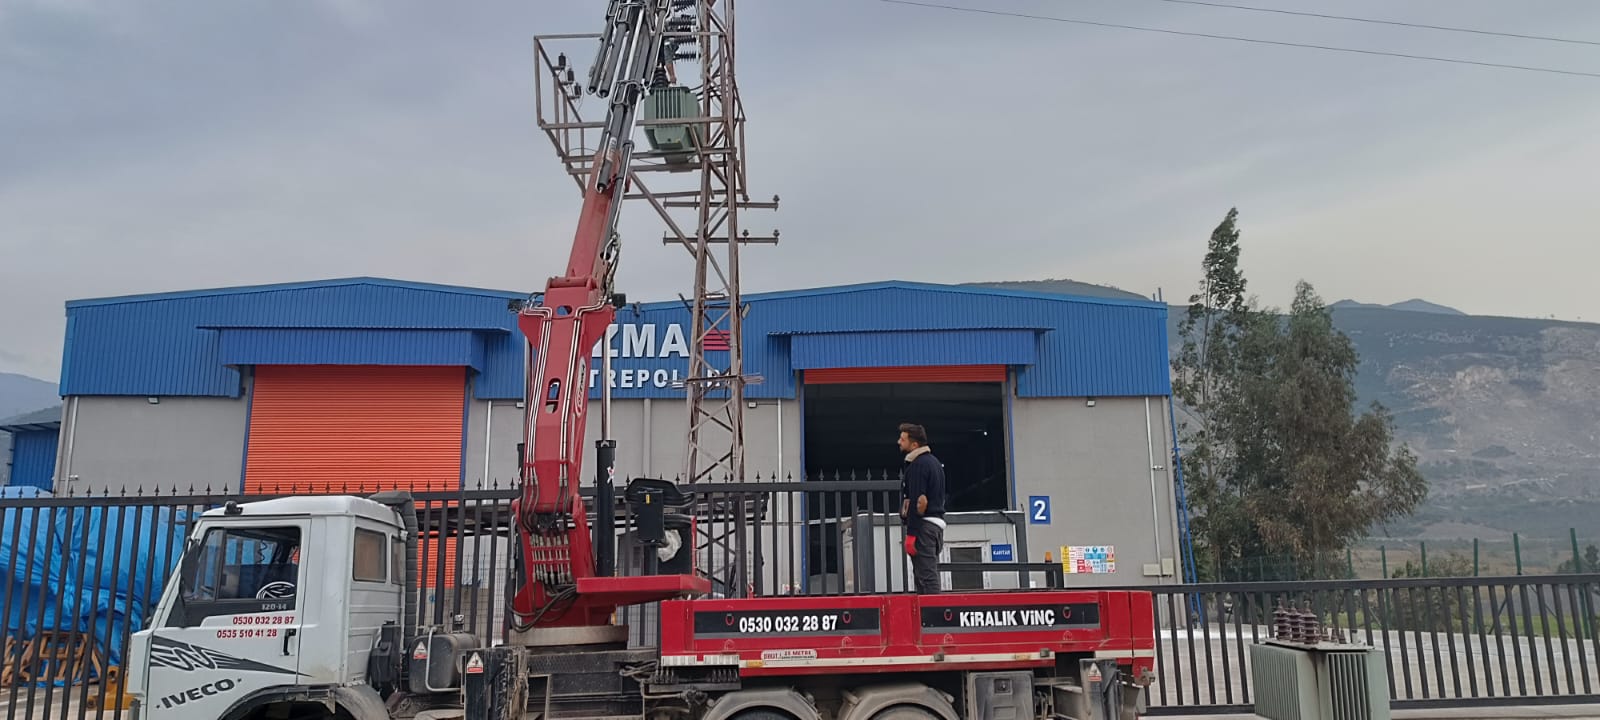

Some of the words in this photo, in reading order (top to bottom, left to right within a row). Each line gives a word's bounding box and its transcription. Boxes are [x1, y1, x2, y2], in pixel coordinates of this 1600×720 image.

[1033, 499, 1047, 521] 2
[232, 616, 253, 625] 0530
[255, 616, 270, 625] 032
[272, 615, 282, 624] 28
[284, 616, 295, 624] 87
[739, 616, 772, 633] 0530
[774, 615, 800, 632] 032
[802, 615, 819, 631] 28
[821, 614, 838, 631] 87
[216, 629, 237, 638] 0535
[239, 628, 253, 638] 510
[255, 628, 264, 637] 41
[266, 628, 277, 637] 28
[161, 678, 235, 709] IVECO
